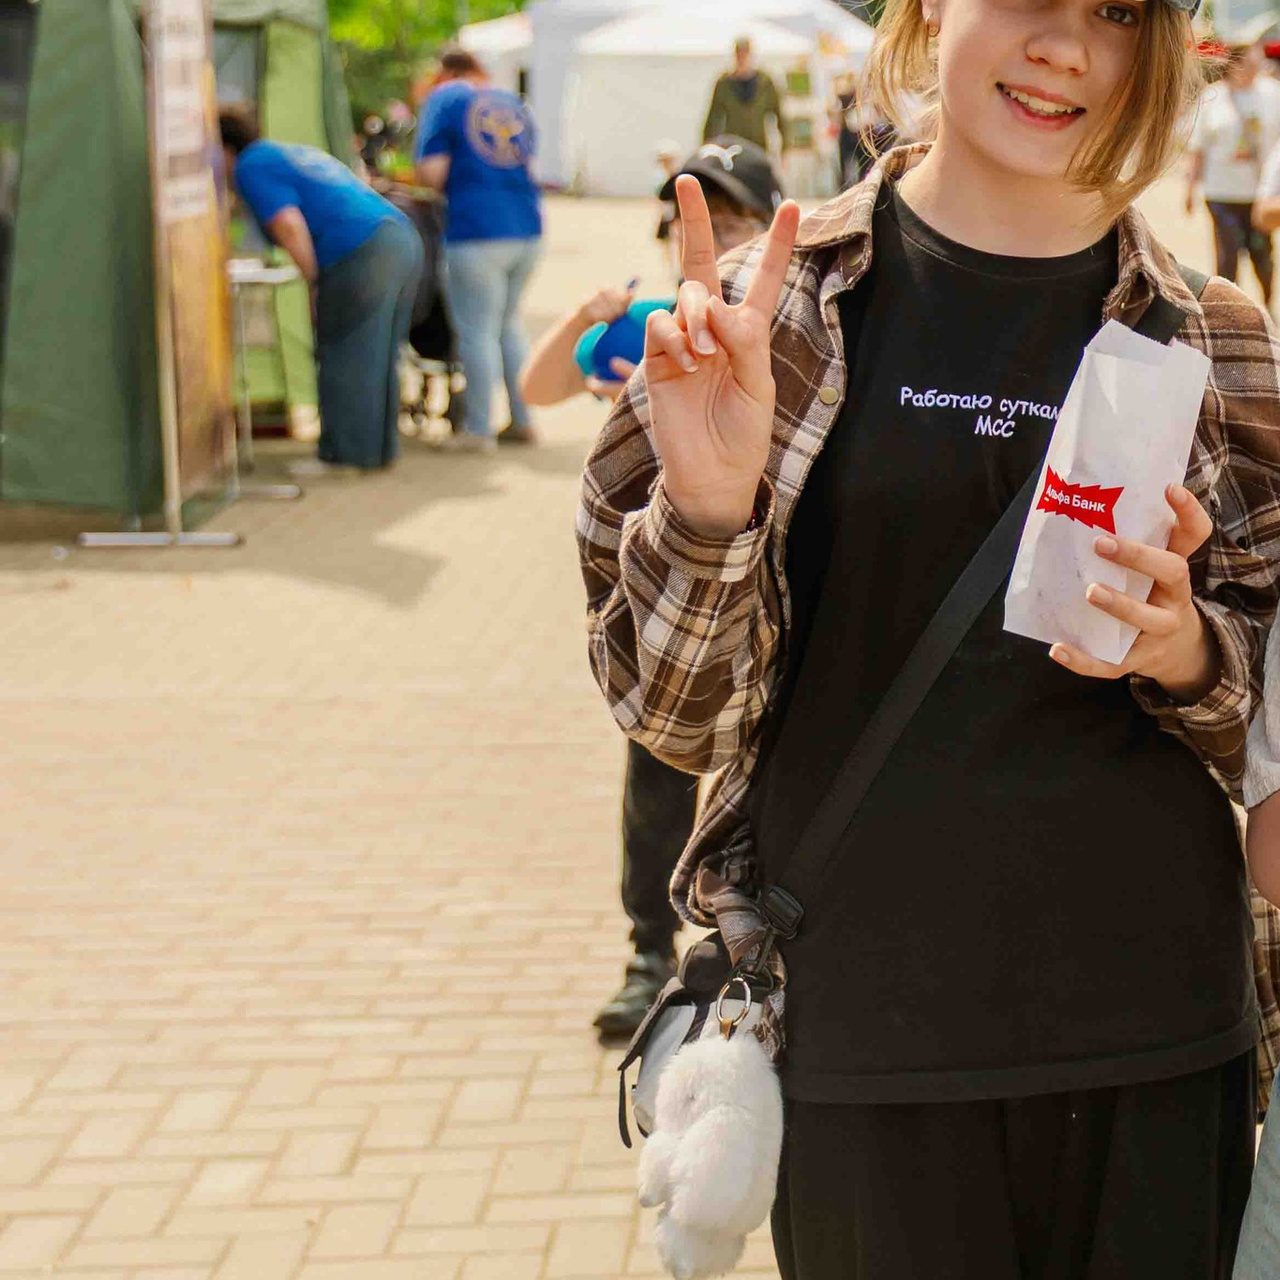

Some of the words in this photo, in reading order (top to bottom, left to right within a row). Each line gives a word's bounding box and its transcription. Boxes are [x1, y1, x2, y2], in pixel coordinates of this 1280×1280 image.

[900, 386, 993, 409] Работаю
[1044, 483, 1070, 505] Альфа
[1071, 494, 1107, 513] Банк
